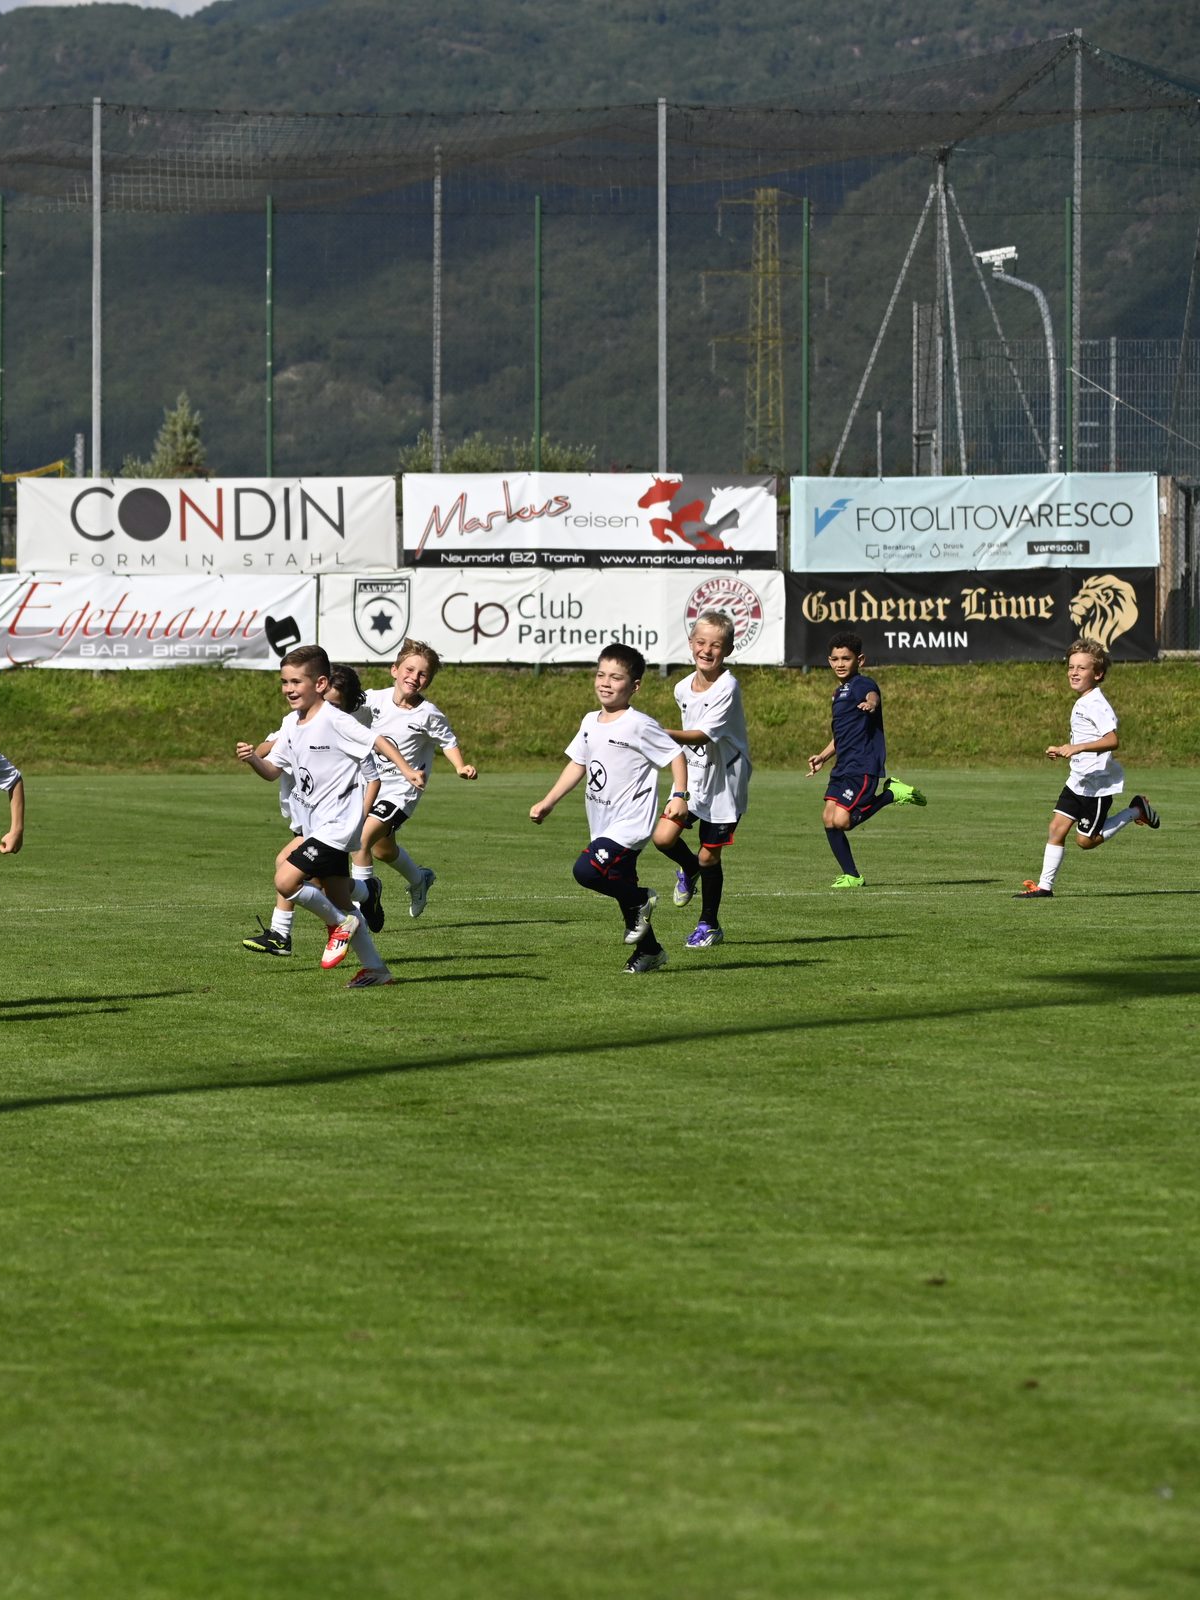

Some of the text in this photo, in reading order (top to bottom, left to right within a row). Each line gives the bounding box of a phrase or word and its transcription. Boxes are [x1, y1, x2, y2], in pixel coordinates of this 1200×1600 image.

[71, 487, 344, 541] CONDIN
[415, 480, 638, 559] Markus reisen
[857, 502, 1134, 532] FOTOLITOVARESCO
[70, 552, 344, 566] FORM IN STAHL
[441, 551, 585, 564] Neumarkt (BZ) Tramin
[600, 553, 744, 565] www.markusreisen.it
[1034, 542, 1084, 553] varesco.it
[518, 592, 583, 619] Club
[689, 579, 759, 611] FC SÜDTIROL
[802, 587, 1054, 623] Goldener Löwe
[6, 581, 264, 665] Egetmann
[518, 623, 658, 650] Partnership
[735, 621, 759, 651] BOZEN
[80, 643, 238, 657] BAR BISTRO
[885, 631, 968, 648] TRAMIN
